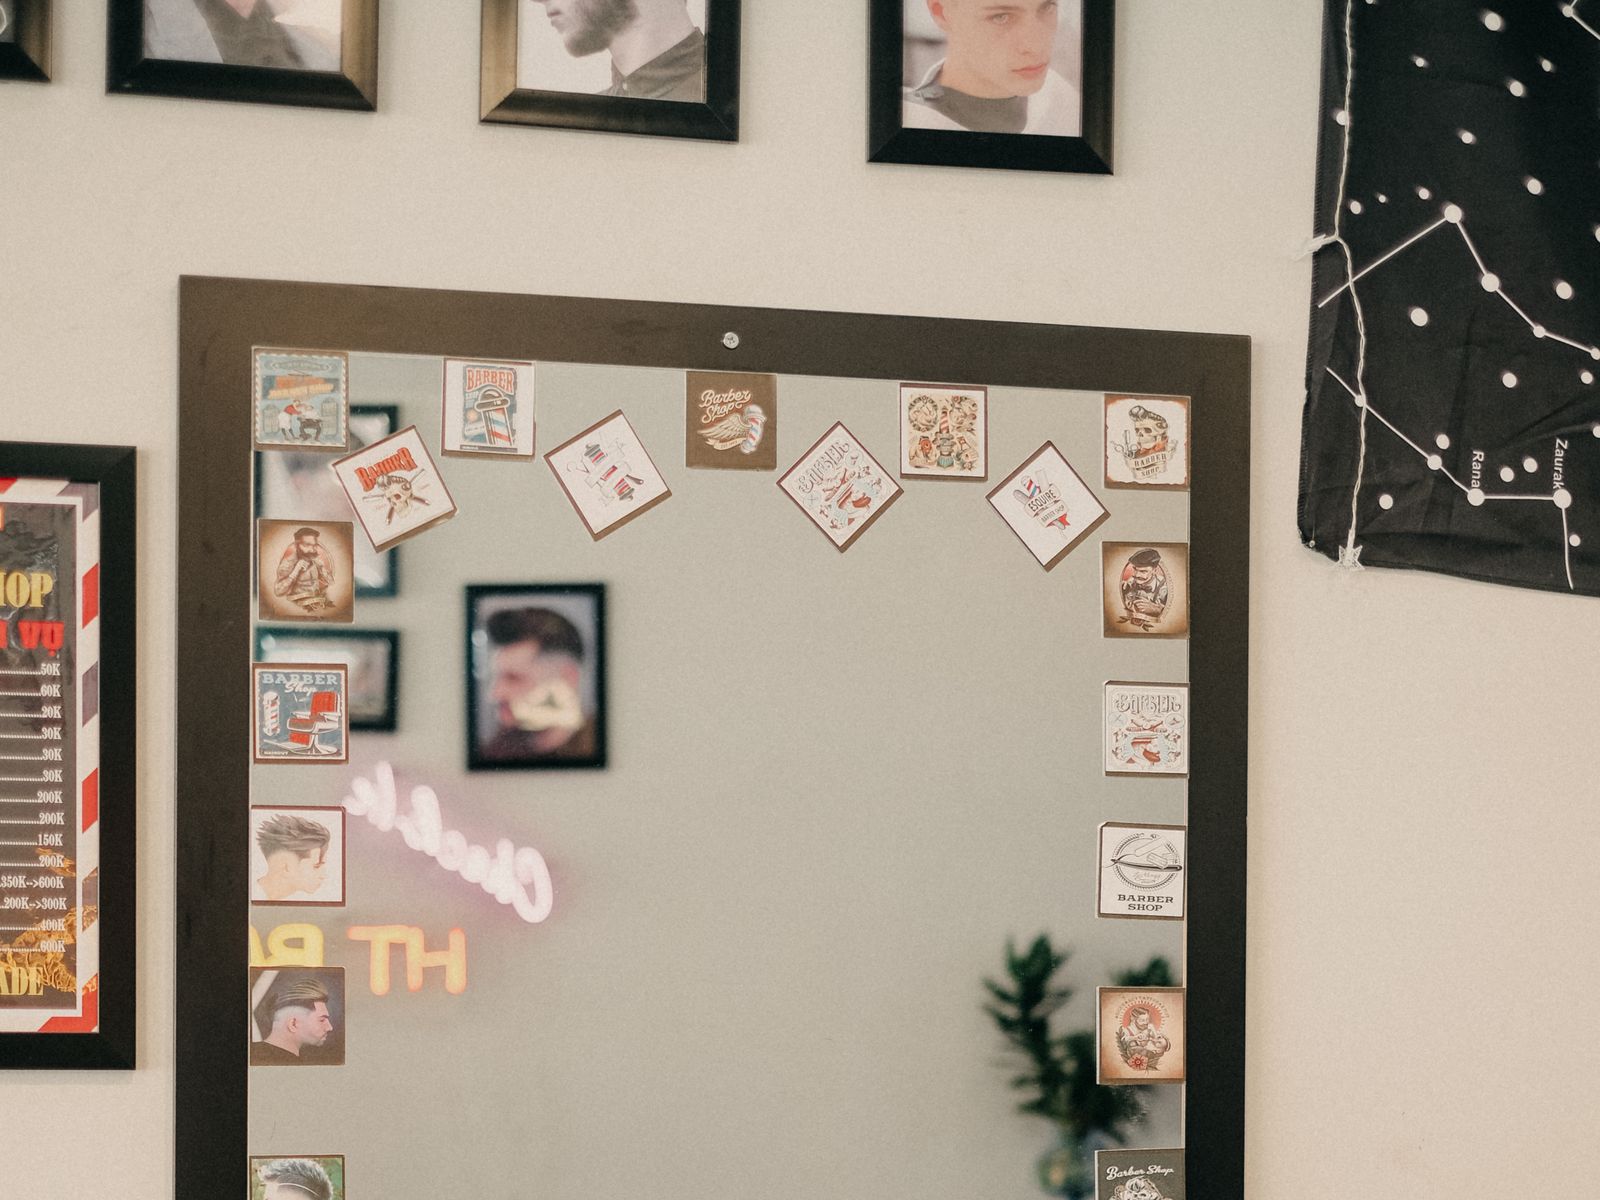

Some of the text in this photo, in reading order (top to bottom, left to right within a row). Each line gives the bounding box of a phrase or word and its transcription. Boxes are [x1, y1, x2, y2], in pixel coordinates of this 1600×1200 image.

[466, 368, 514, 395] BARBER
[699, 389, 751, 408] Barber
[702, 403, 735, 423] Shop
[1471, 450, 1485, 488] Rana
[1552, 438, 1568, 490] Zaurak
[1028, 489, 1057, 512] ESQUIRE
[41, 663, 61, 676] 50K
[262, 673, 338, 685] BARBER
[41, 684, 61, 697] 60K
[284, 681, 317, 697] Shop
[42, 706, 62, 718] 20K
[42, 727, 62, 740] 30K
[42, 748, 62, 761] 30K
[43, 769, 63, 782] 30K
[37, 790, 63, 803] 200K
[39, 812, 65, 825] 200K
[38, 833, 63, 846] 150K
[39, 855, 65, 868] 200K
[1117, 894, 1174, 903] BARBER
[1128, 904, 1163, 912] SHOP
[40, 918, 66, 931] 400K
[1106, 1165, 1174, 1180] Barber Shop
